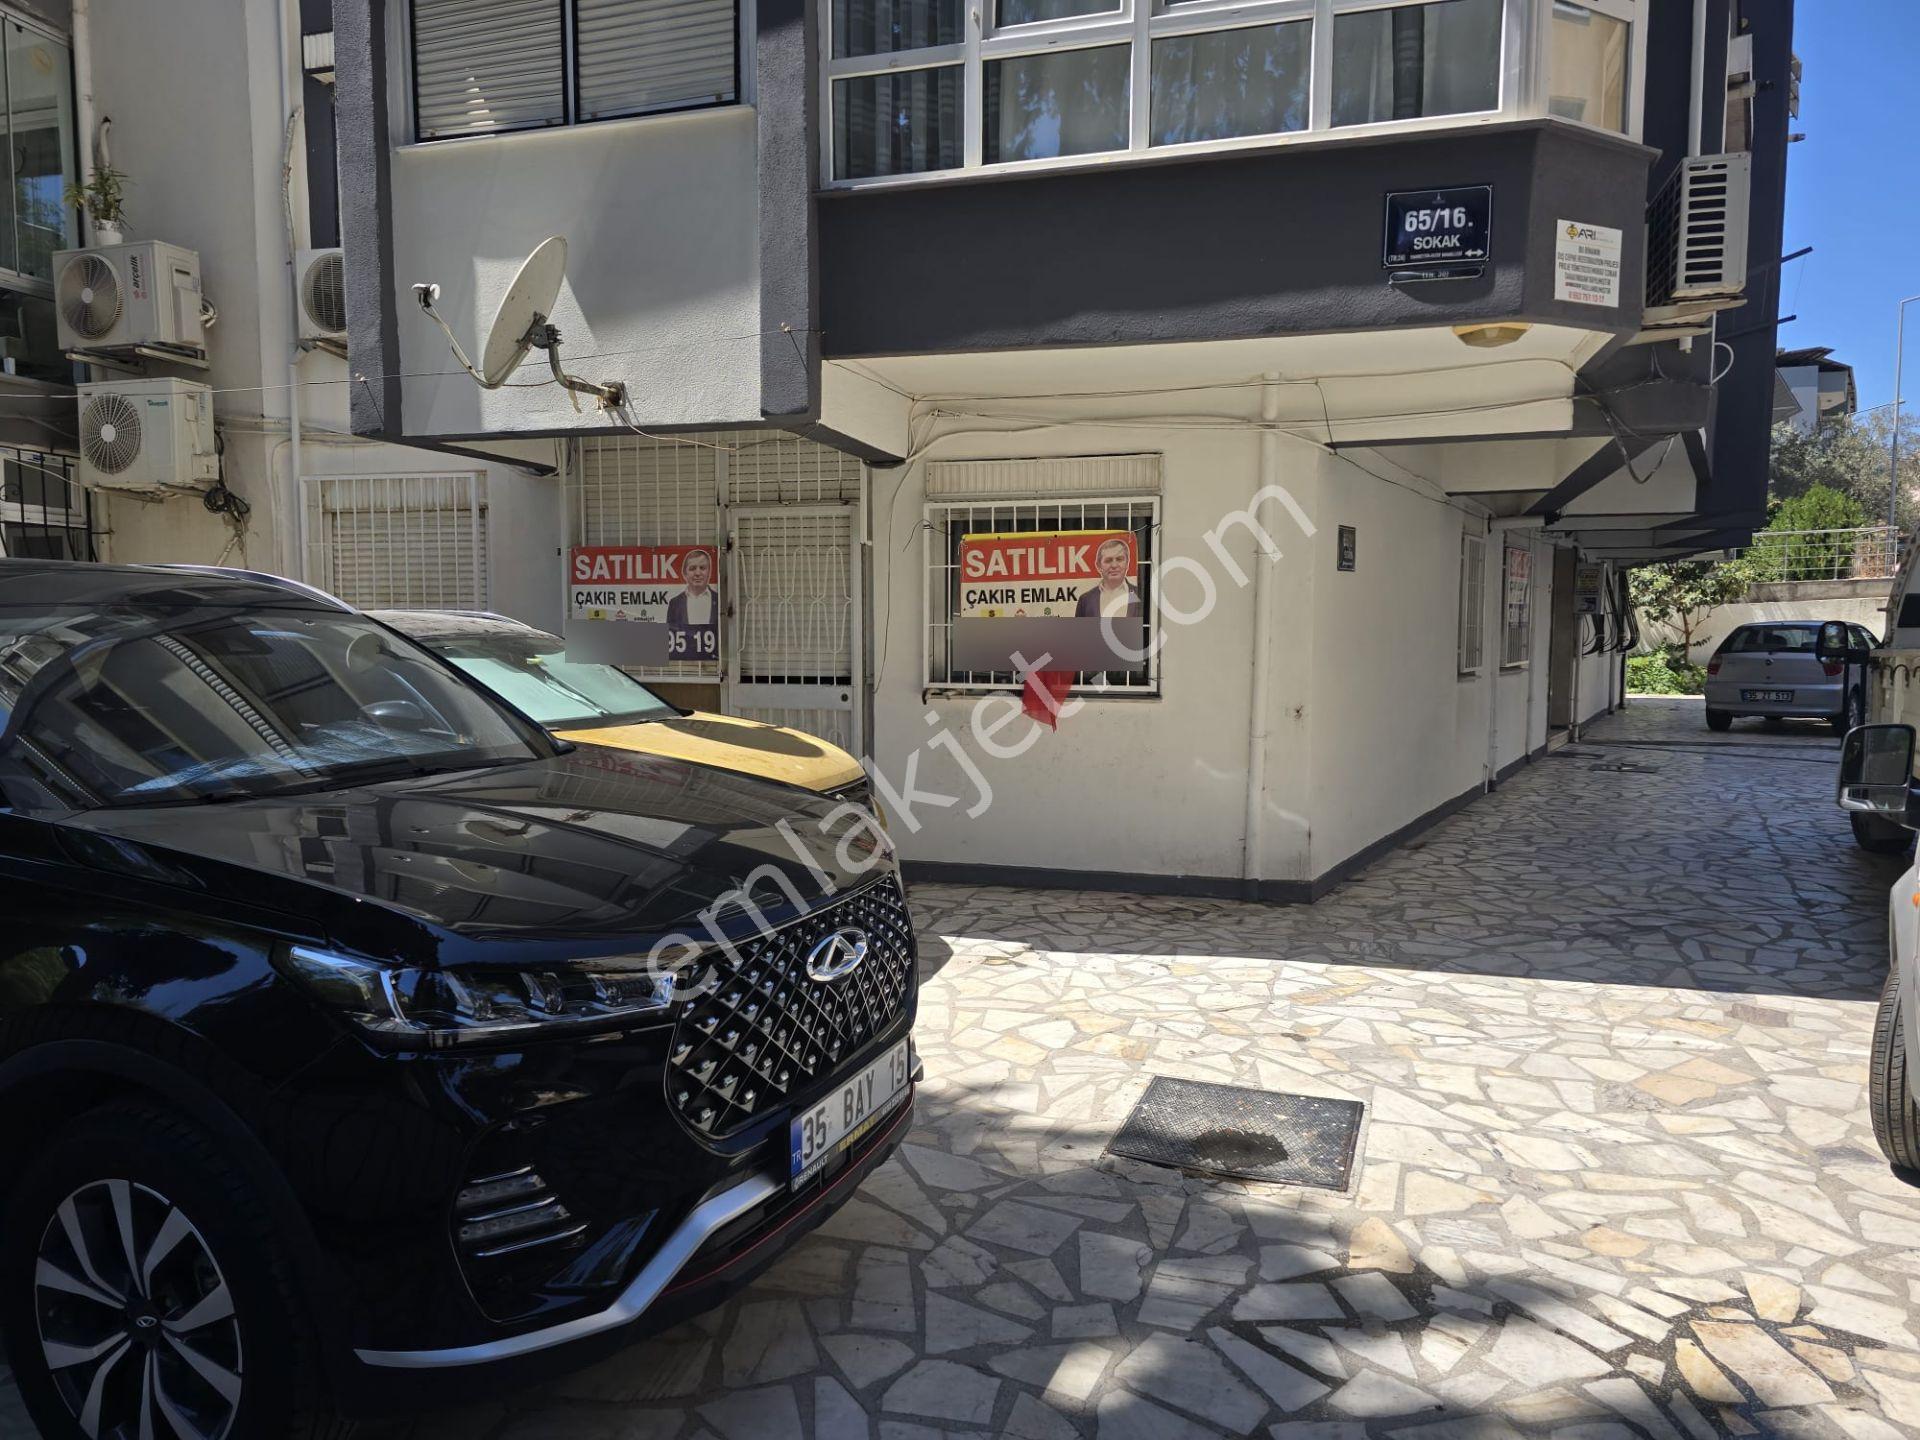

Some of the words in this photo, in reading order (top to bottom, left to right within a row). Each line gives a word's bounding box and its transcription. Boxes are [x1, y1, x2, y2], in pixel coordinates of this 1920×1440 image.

[1413, 234, 1461, 250] SOKAK
[575, 553, 679, 580] SATILIK
[965, 544, 1092, 578] SATILIK
[575, 591, 616, 609] ÇAKIR
[620, 591, 669, 605] EMLAK
[966, 589, 1016, 609] ÇAKIR
[1021, 586, 1078, 603] EMLAK
[693, 630, 716, 653] 19
[803, 1106, 827, 1160] 35
[843, 1069, 875, 1131] BAY
[889, 1046, 905, 1091] 15
[792, 1151, 802, 1165] TR
[798, 1155, 829, 1183] RENAULT
